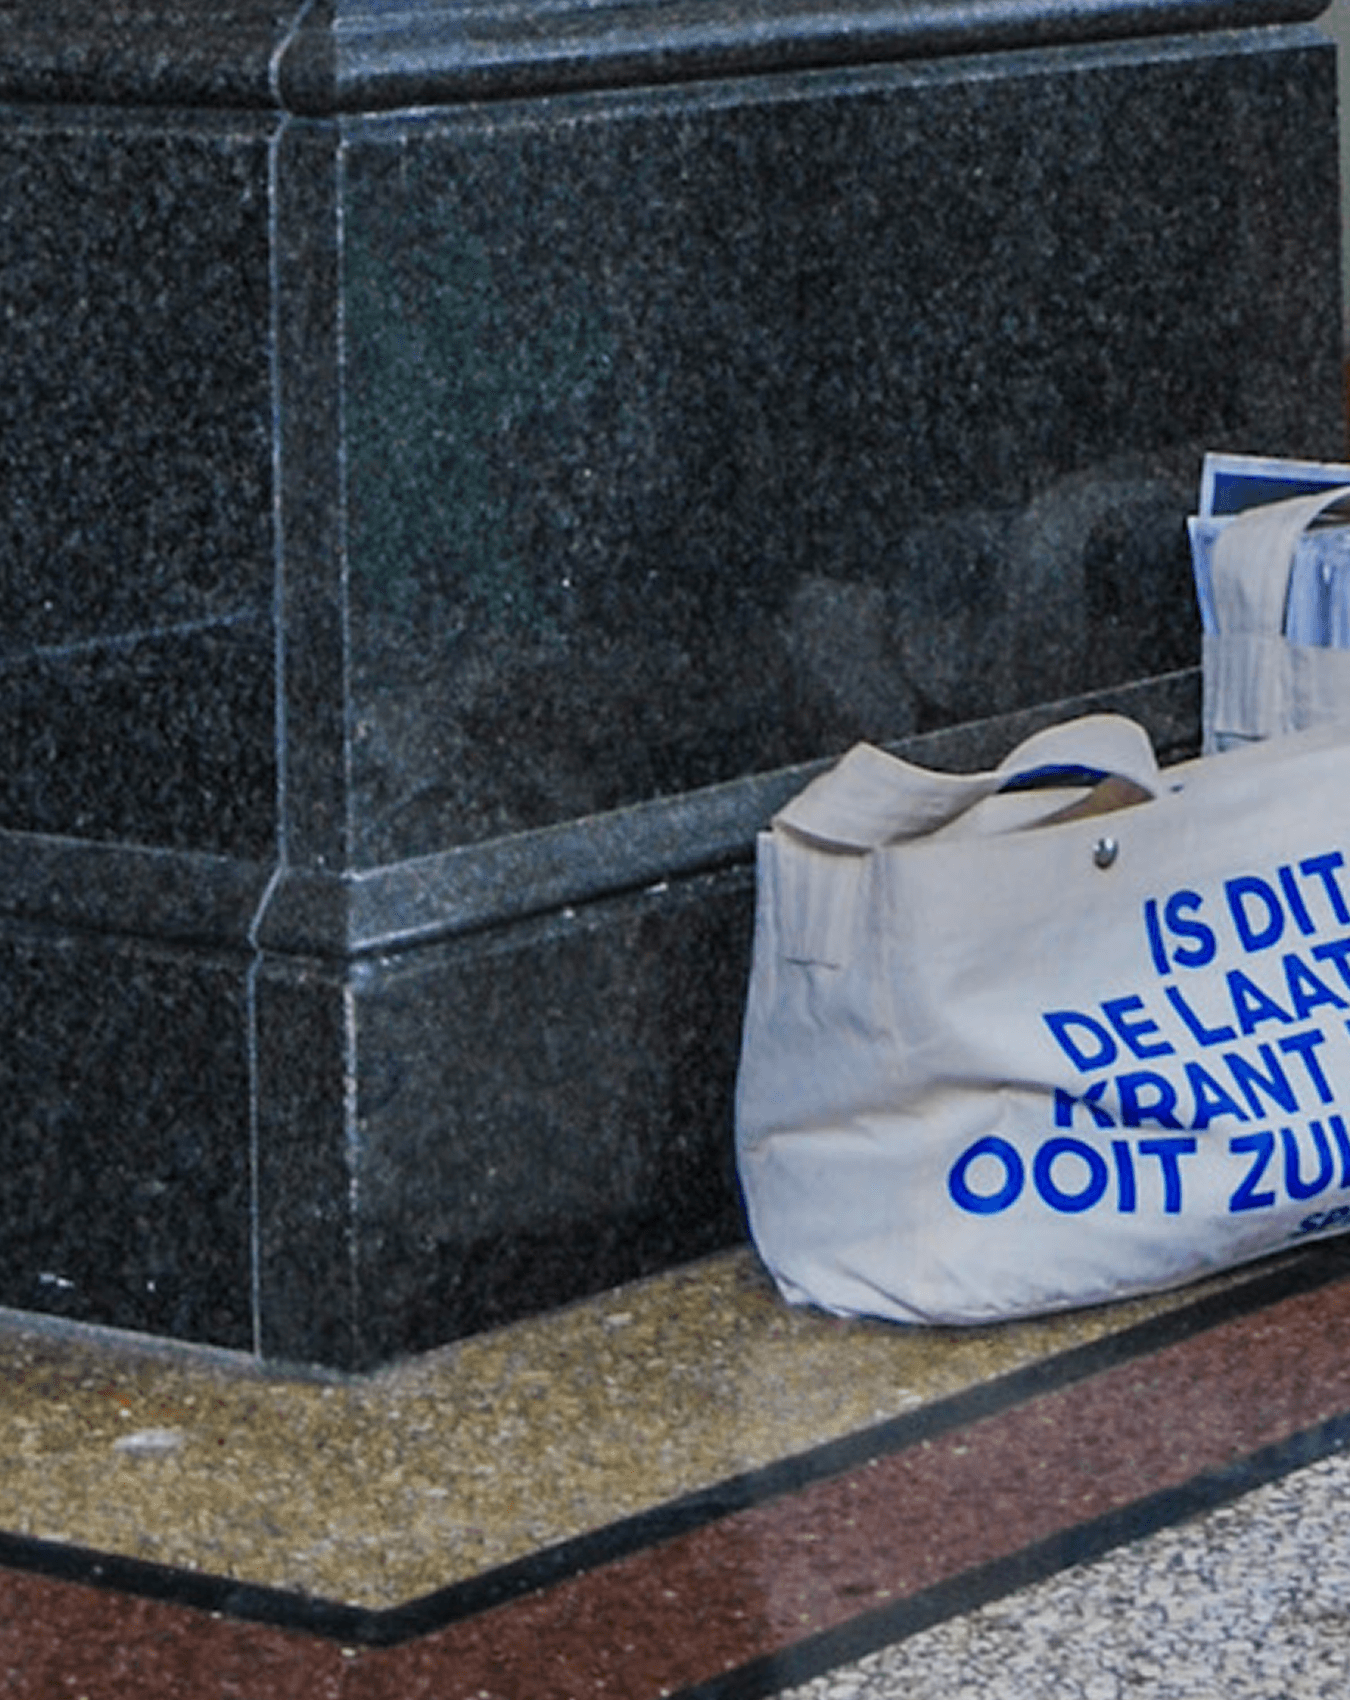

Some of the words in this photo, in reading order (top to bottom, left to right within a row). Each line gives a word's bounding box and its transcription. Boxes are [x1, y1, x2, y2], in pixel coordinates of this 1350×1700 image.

[1142, 888, 1220, 979] IS
[1040, 993, 1179, 1077] DE
[1050, 1025, 1337, 1135] KRANT
[943, 1133, 1200, 1219] OOIT
